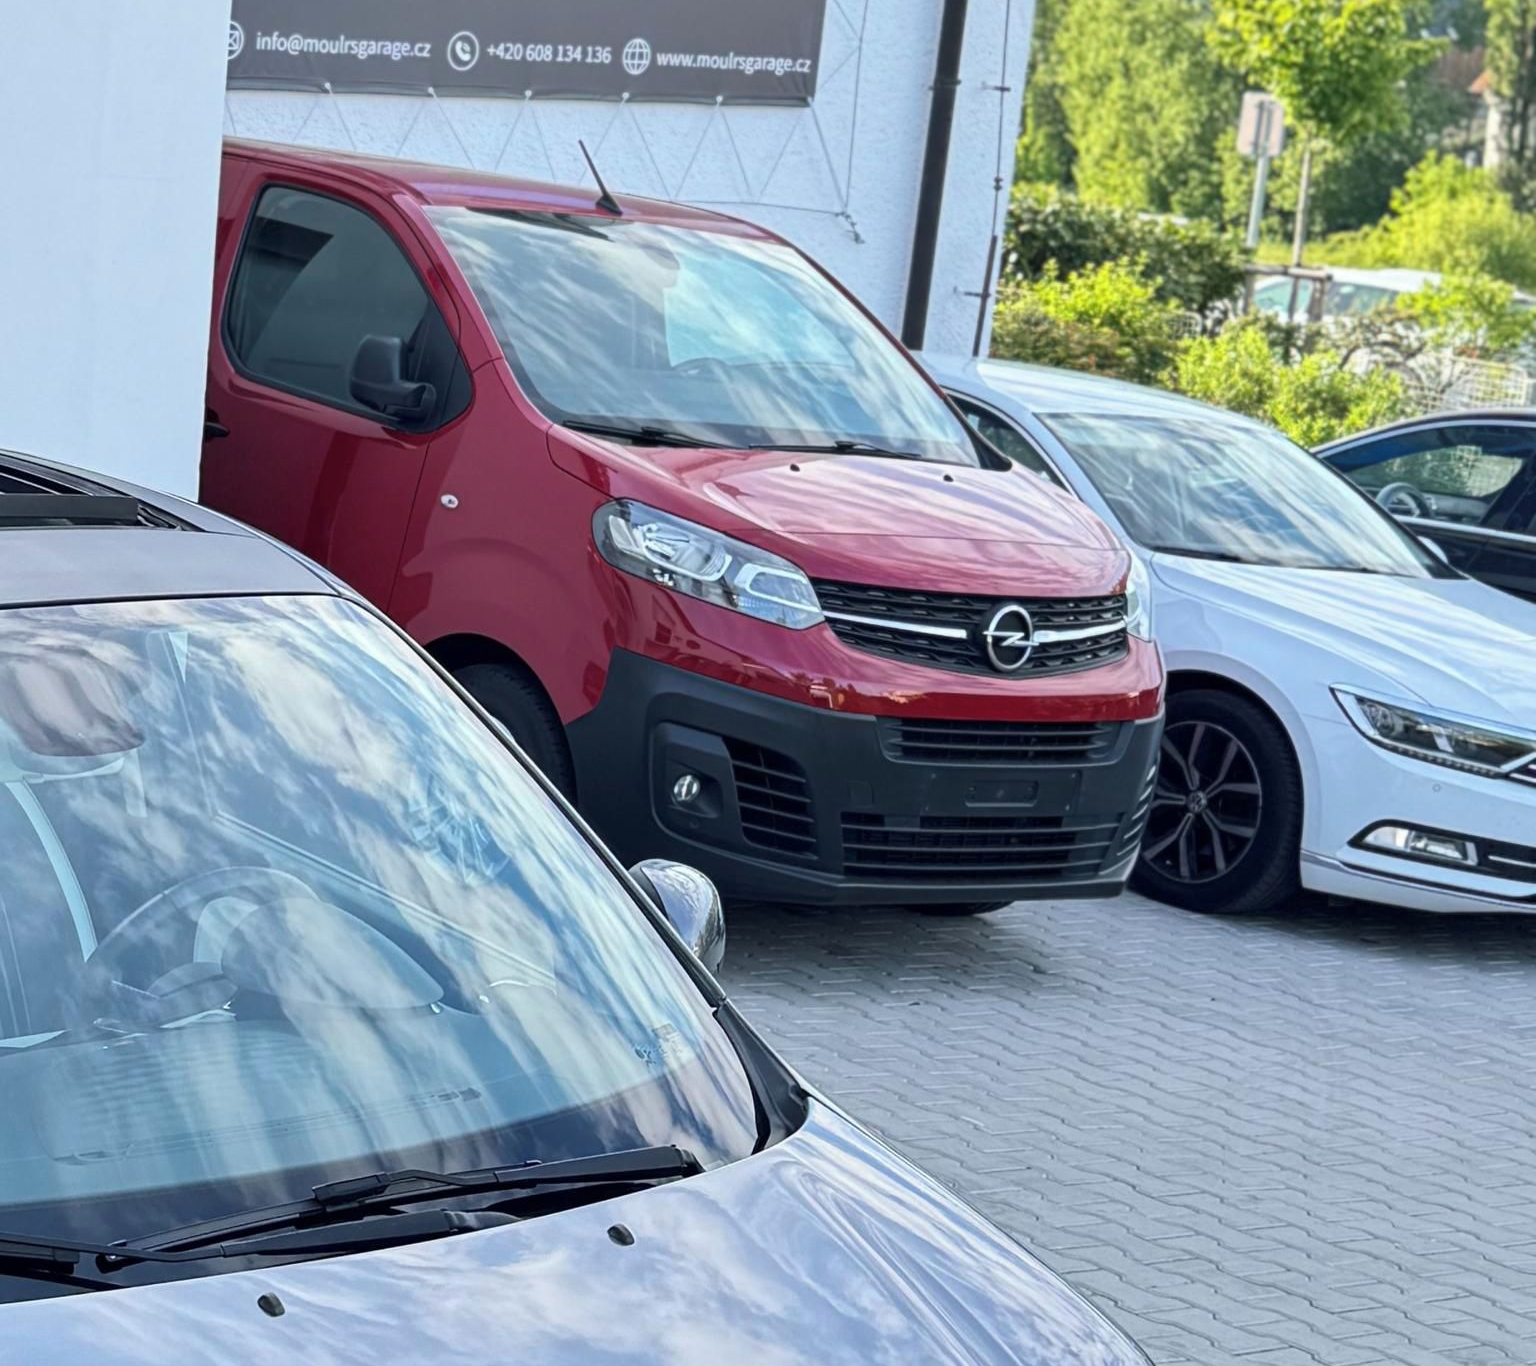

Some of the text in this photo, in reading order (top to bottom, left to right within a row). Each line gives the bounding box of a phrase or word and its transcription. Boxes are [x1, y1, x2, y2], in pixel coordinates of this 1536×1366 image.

[255, 31, 812, 76] info@moulrsgarage.cz +420 608 134 136 www.moulrsgarage.cz
